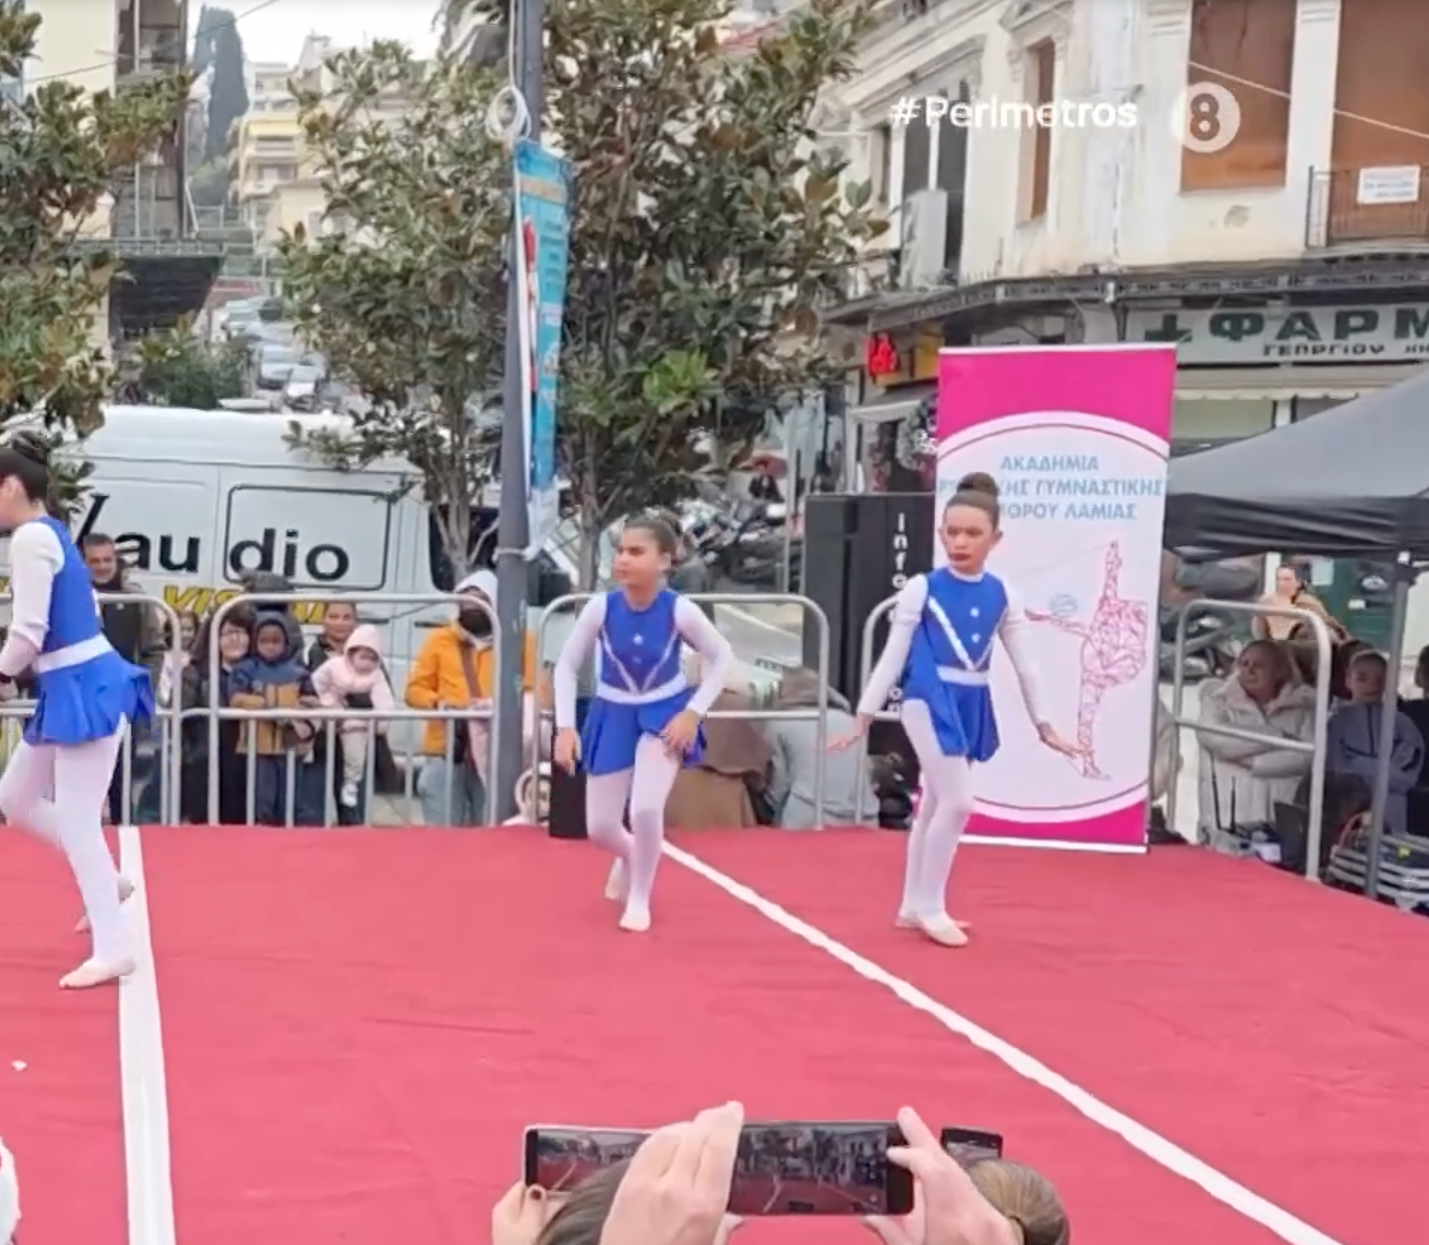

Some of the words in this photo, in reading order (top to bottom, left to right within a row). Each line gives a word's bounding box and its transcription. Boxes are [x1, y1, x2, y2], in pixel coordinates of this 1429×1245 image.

[1000, 455, 1100, 471] ΑΚΑΔΗΜΙΑ
[1036, 479, 1163, 496] ΓΥΜΝΑΣΤΙΚΗΣ
[1065, 503, 1137, 519] ΛΑΜΙΑΣ
